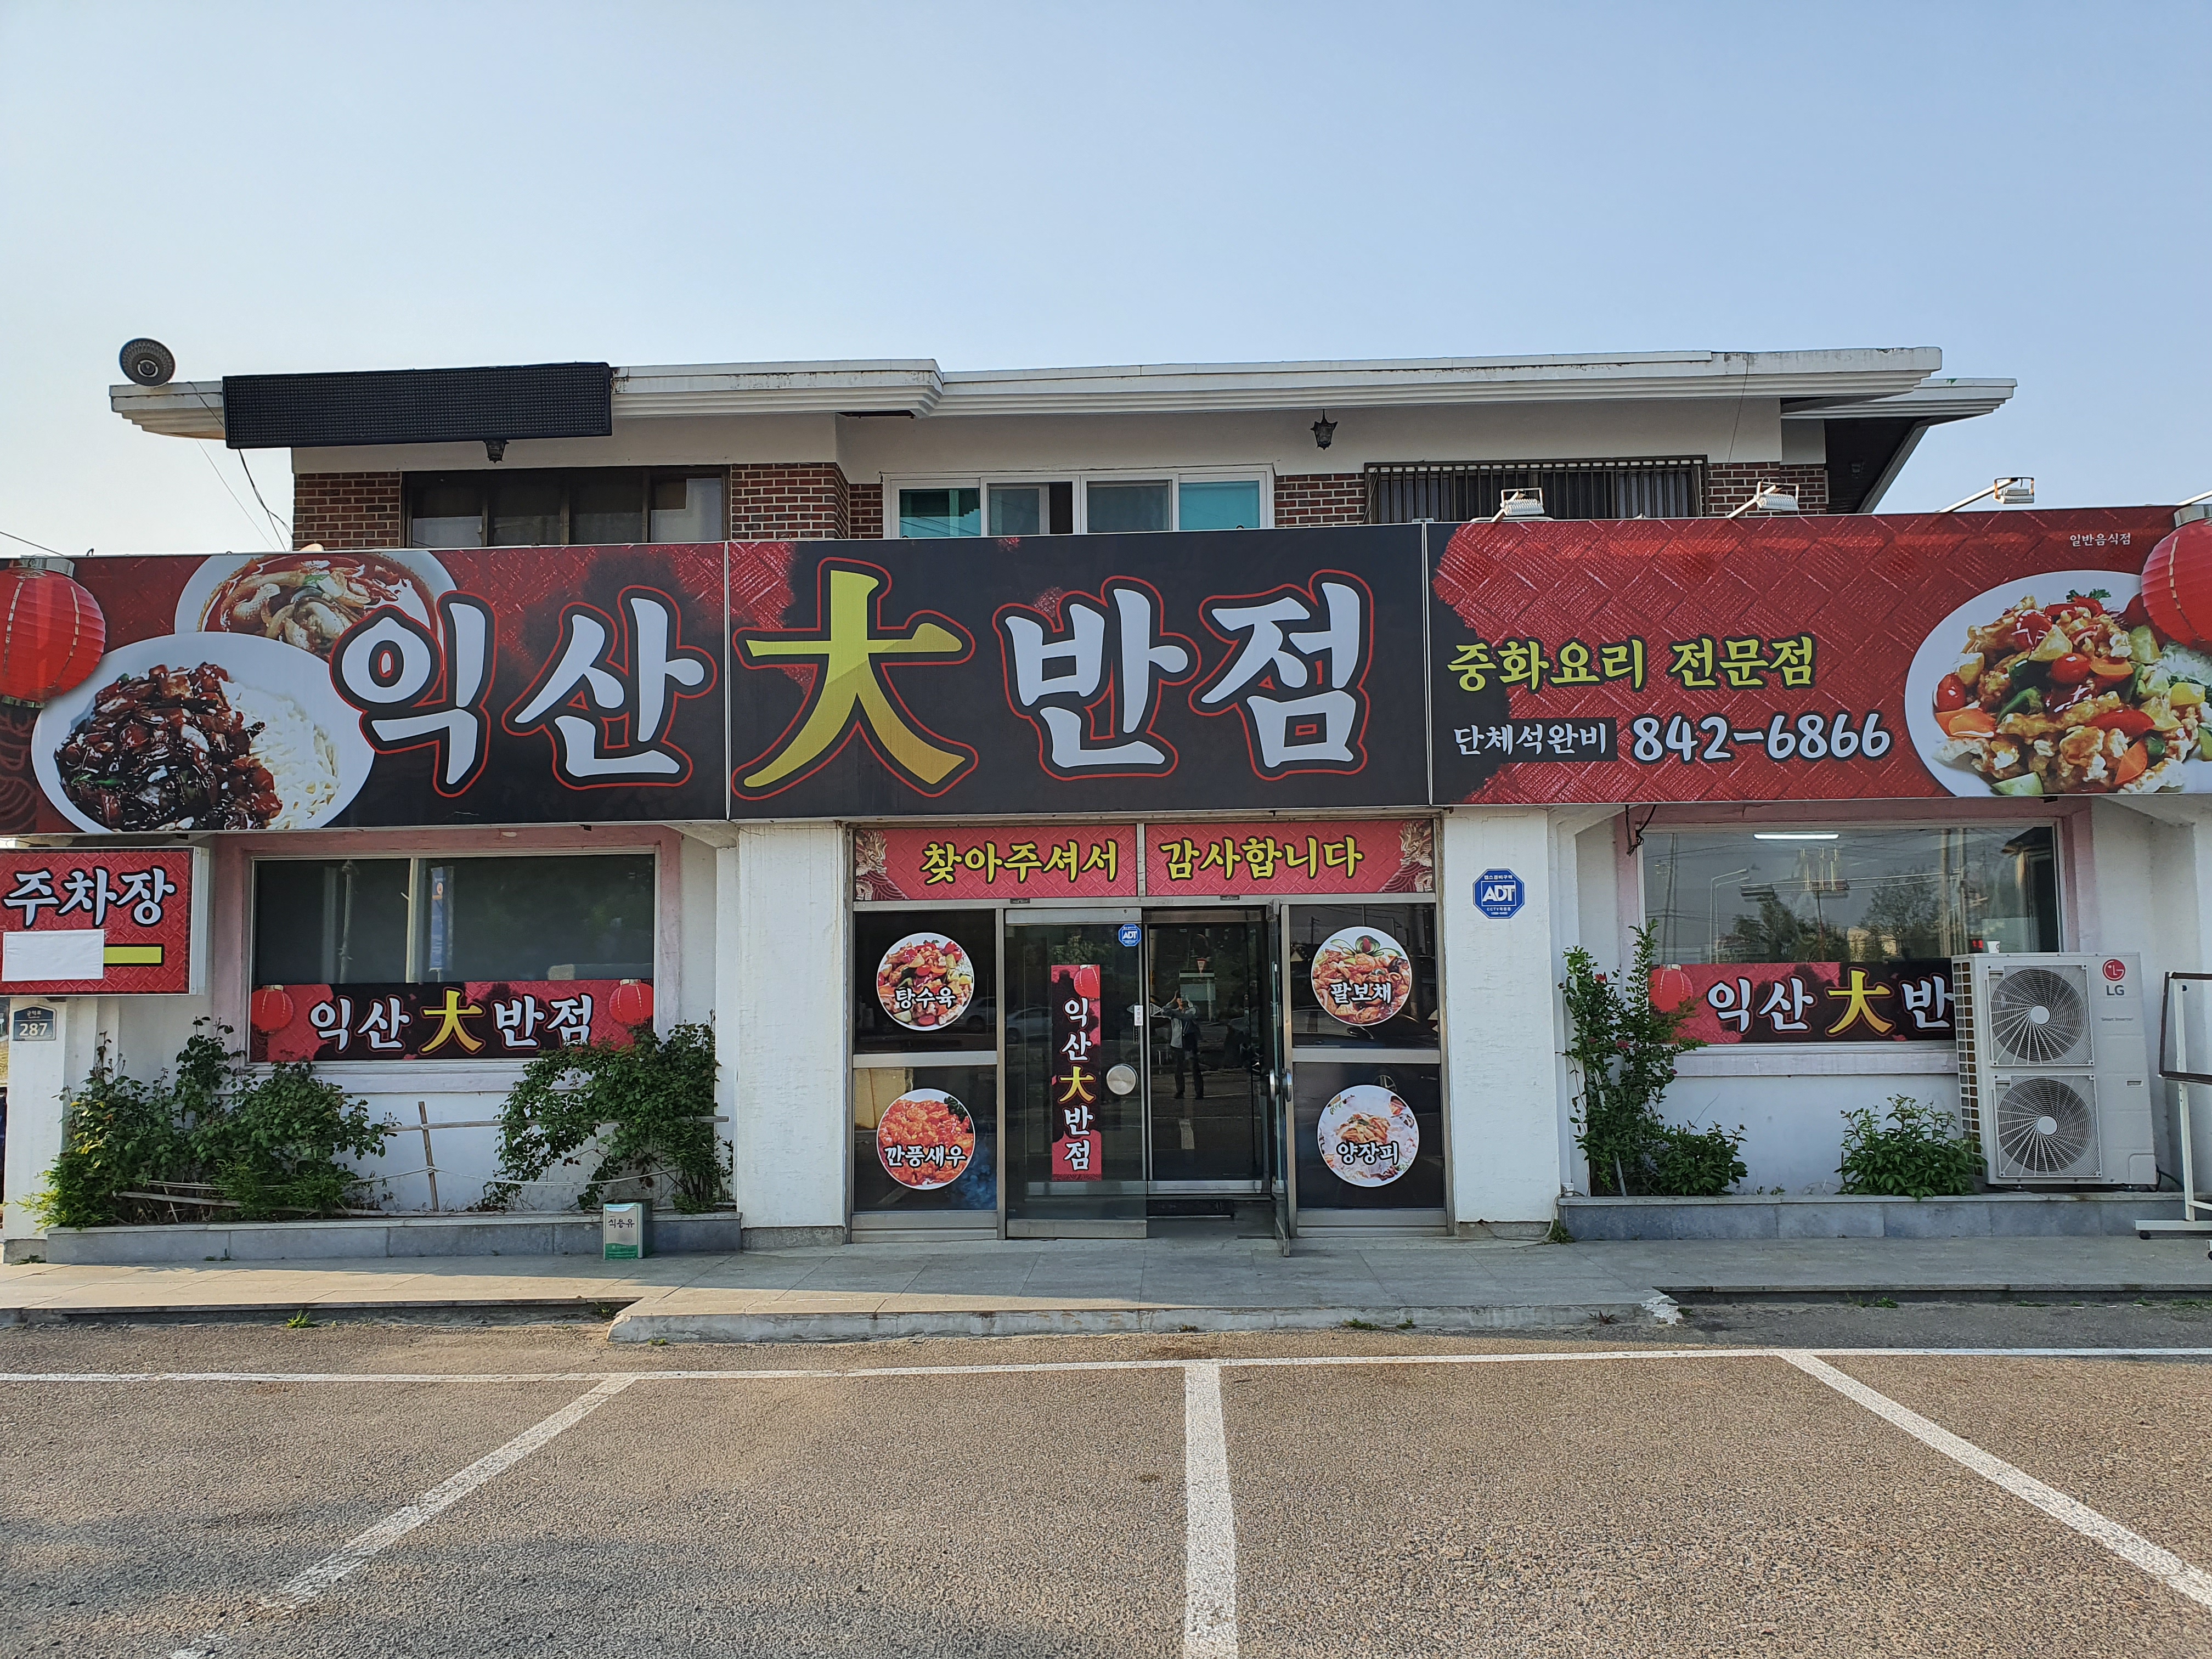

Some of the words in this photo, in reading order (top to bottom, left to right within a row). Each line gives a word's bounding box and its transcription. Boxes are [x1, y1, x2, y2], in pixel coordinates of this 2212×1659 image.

[2070, 532, 2131, 547] 일반음식점
[1447, 638, 1644, 691] 중화요리
[1669, 636, 1814, 688] 전문점
[1454, 721, 1607, 757] 단체석완비
[1633, 713, 1891, 761] 842-6866
[921, 838, 1118, 885] 찾아주셔서
[1160, 836, 1364, 880] 감사합니다
[3, 868, 175, 927] 주차장
[1482, 885, 1516, 901] ADT
[1122, 931, 1137, 939] ADT
[895, 987, 956, 1009] 탕수육
[1331, 982, 1392, 1003] 팔보채
[2106, 985, 2124, 996] LG
[19, 1023, 48, 1036] 287
[884, 1145, 967, 1167] 깐풍새우
[1338, 1142, 1398, 1164] 양장피
[608, 1218, 635, 1228] 식용유
